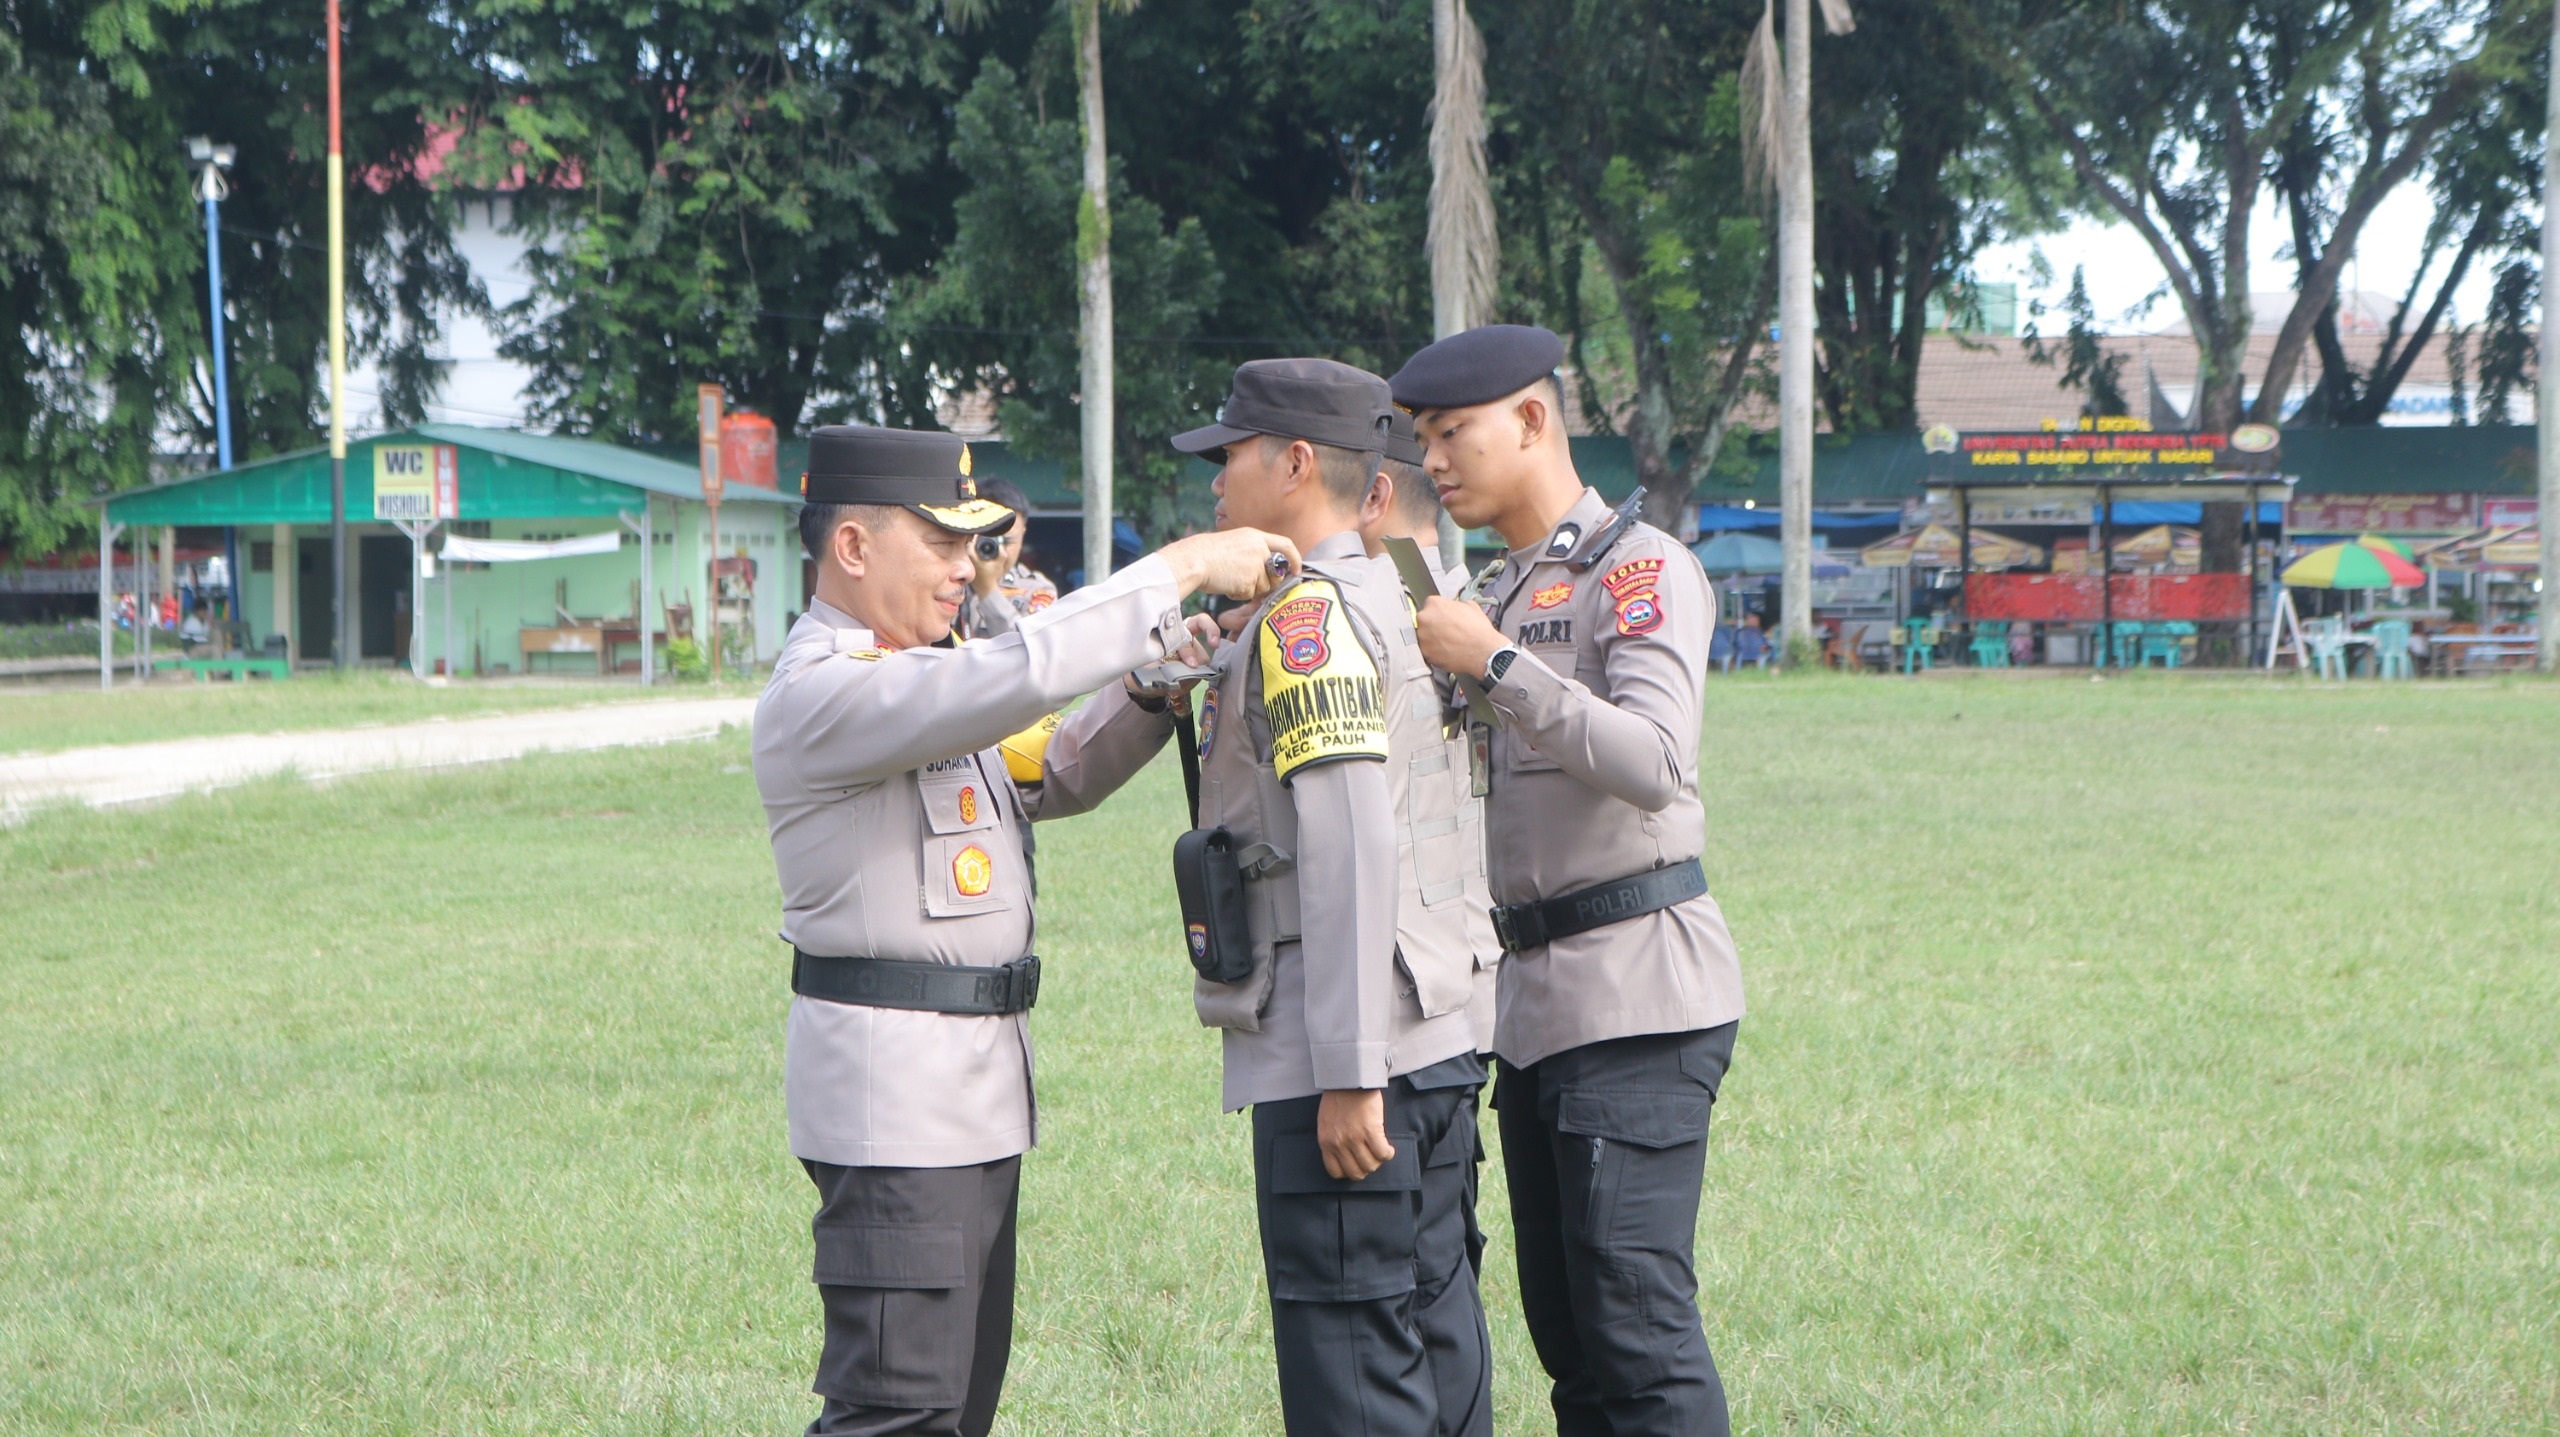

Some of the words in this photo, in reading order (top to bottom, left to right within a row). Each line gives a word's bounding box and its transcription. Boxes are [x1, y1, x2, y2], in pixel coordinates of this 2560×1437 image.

[2096, 415, 2153, 432] DIGITAL
[1963, 434, 2056, 451] UNIVERSITAS
[2059, 434, 2109, 450] PUTRA
[2112, 433, 2187, 450] INDONESIA
[385, 451, 423, 475] WC
[1971, 450, 2022, 466] KARYA
[2026, 450, 2090, 465] BASAMO
[2093, 449, 2153, 464] UNTUAK
[2157, 448, 2215, 464] NAGARI
[378, 494, 430, 518] MUSHOLLA
[1608, 560, 1658, 586] POLDA
[1274, 601, 1322, 621] POLRESTA
[1518, 619, 1572, 646] POLRI
[1289, 721, 1338, 746] LIMAU
[1342, 720, 1386, 734] MANIS
[1284, 741, 1315, 763] KEC.
[1321, 733, 1366, 748] PAUH
[1575, 885, 1643, 923] POLRI
